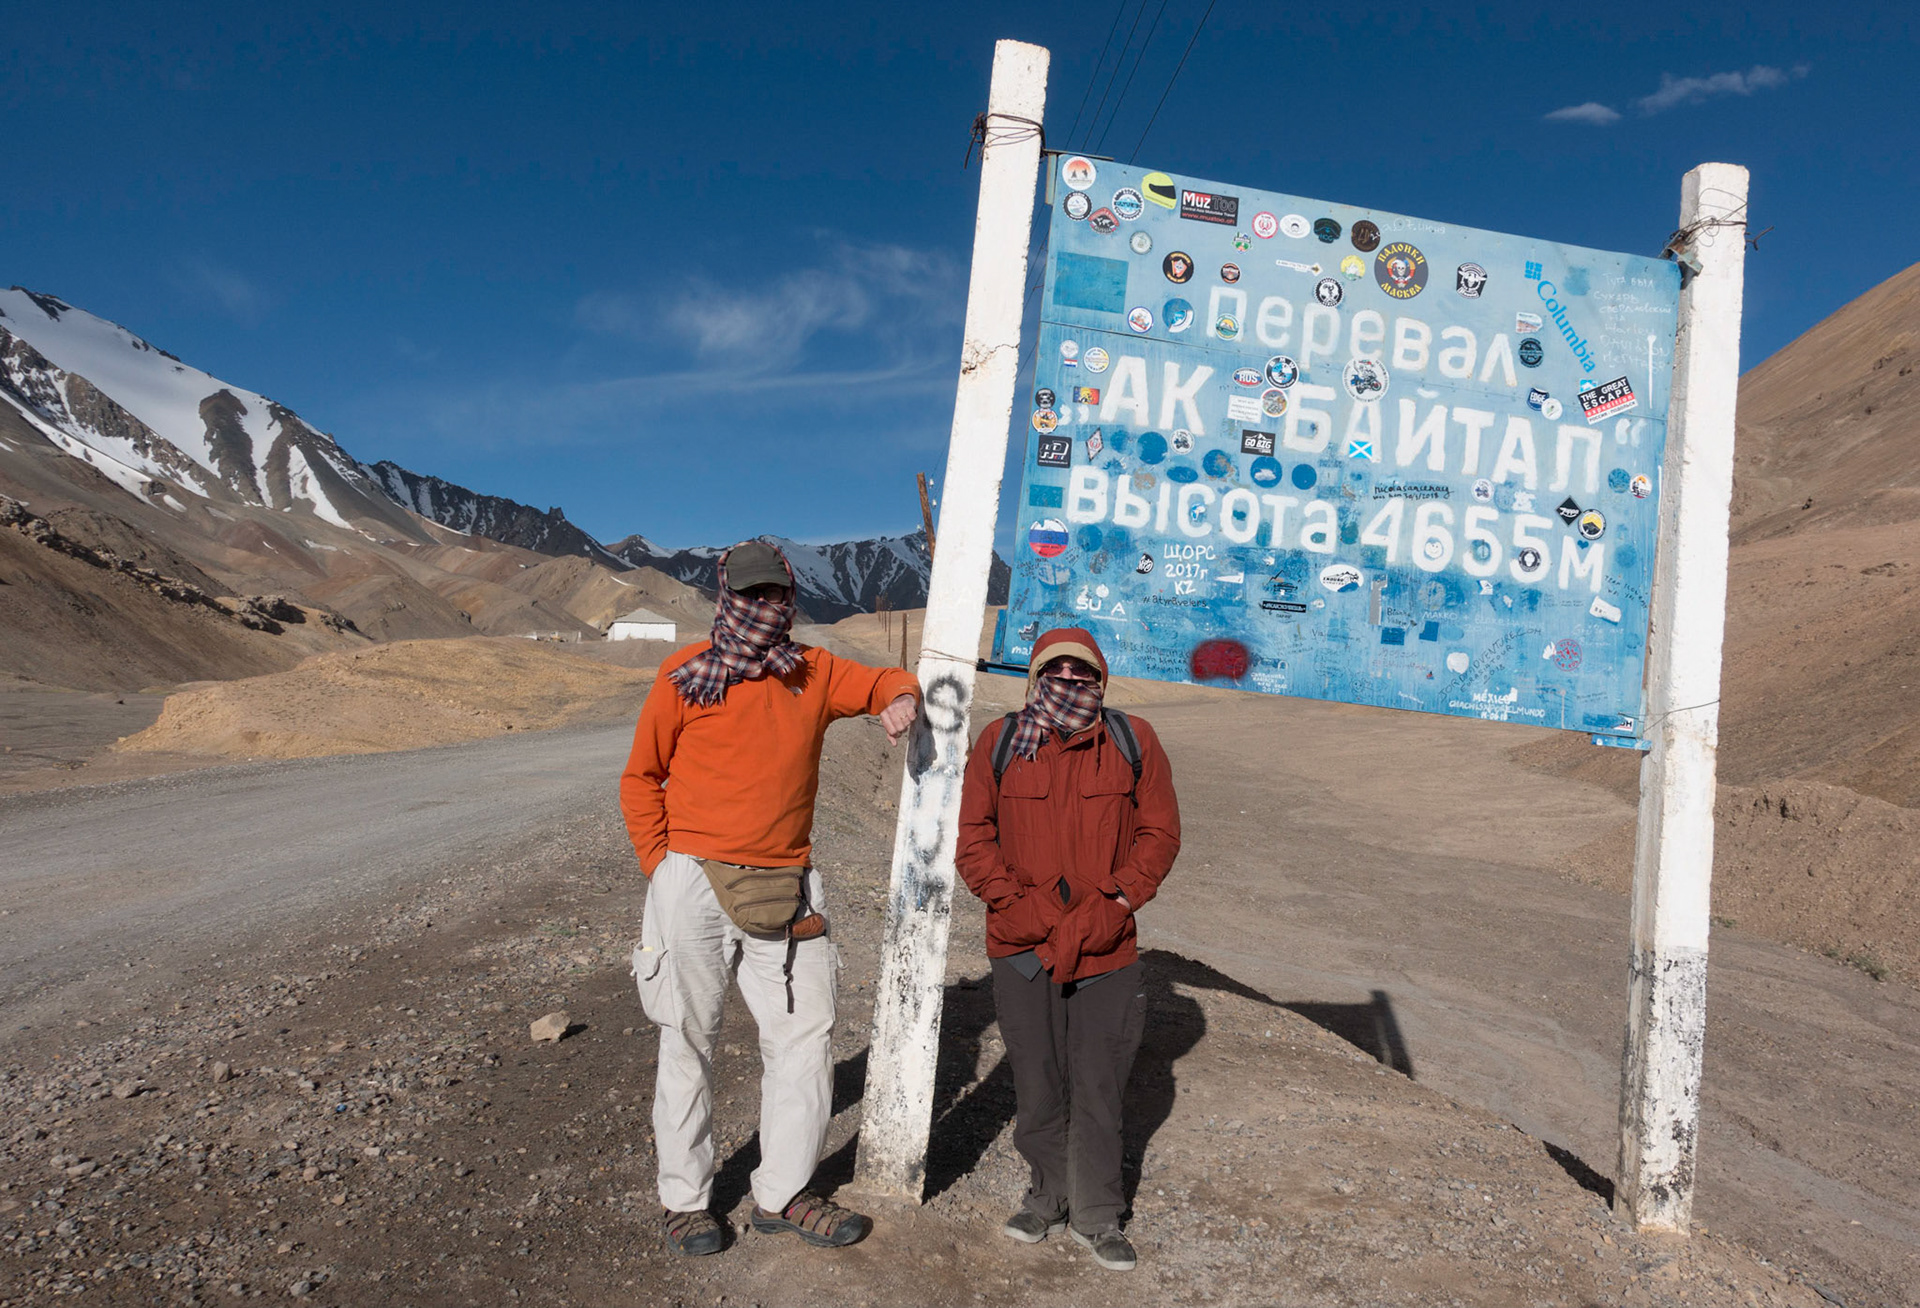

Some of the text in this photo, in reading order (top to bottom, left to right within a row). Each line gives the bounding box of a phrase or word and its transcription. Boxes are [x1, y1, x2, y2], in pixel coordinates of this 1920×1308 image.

[1377, 243, 1425, 265] ПАДОНКИ
[1380, 282, 1422, 299] МАСКВА
[1537, 279, 1596, 374] Columbia
[1238, 373, 1259, 383] RUS
[1580, 379, 1627, 402] THE GREAT
[1583, 386, 1632, 411] ESCAPE
[1587, 395, 1633, 416] expedition
[1244, 437, 1272, 449] GO BIG
[1164, 544, 1216, 561] ЩОРС
[1174, 580, 1196, 595] KZ
